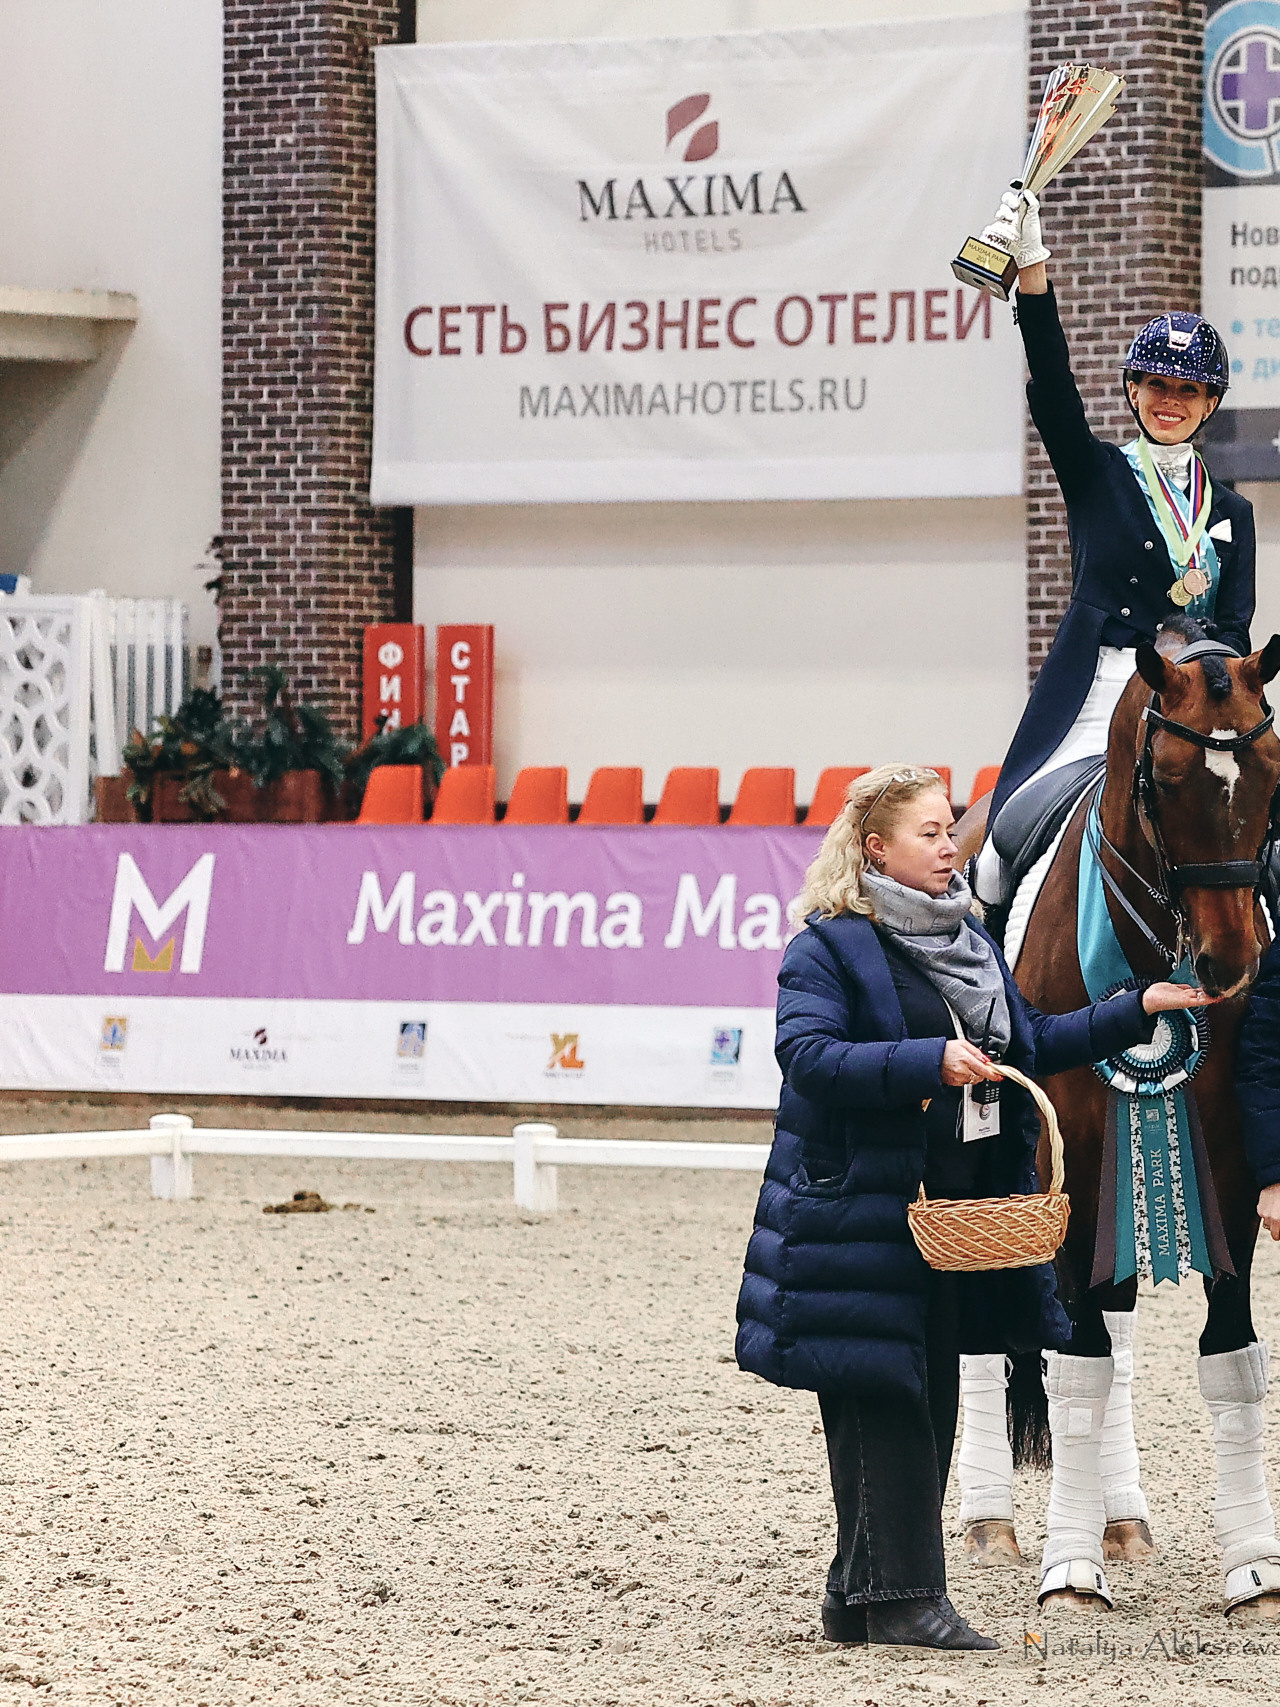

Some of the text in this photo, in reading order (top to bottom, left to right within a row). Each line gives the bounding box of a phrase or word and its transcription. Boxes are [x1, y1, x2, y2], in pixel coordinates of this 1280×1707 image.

[576, 171, 808, 222] MAXIMA
[643, 227, 744, 255] HOTELS
[403, 303, 528, 357] СЕТЬ
[543, 296, 757, 354] БИЗНЕС
[518, 377, 868, 419] MAXIMAHOTELS.RU
[450, 641, 471, 768] СТАР
[347, 871, 645, 949] Maxima
[1152, 1149, 1170, 1256] MAXIMA PARK
